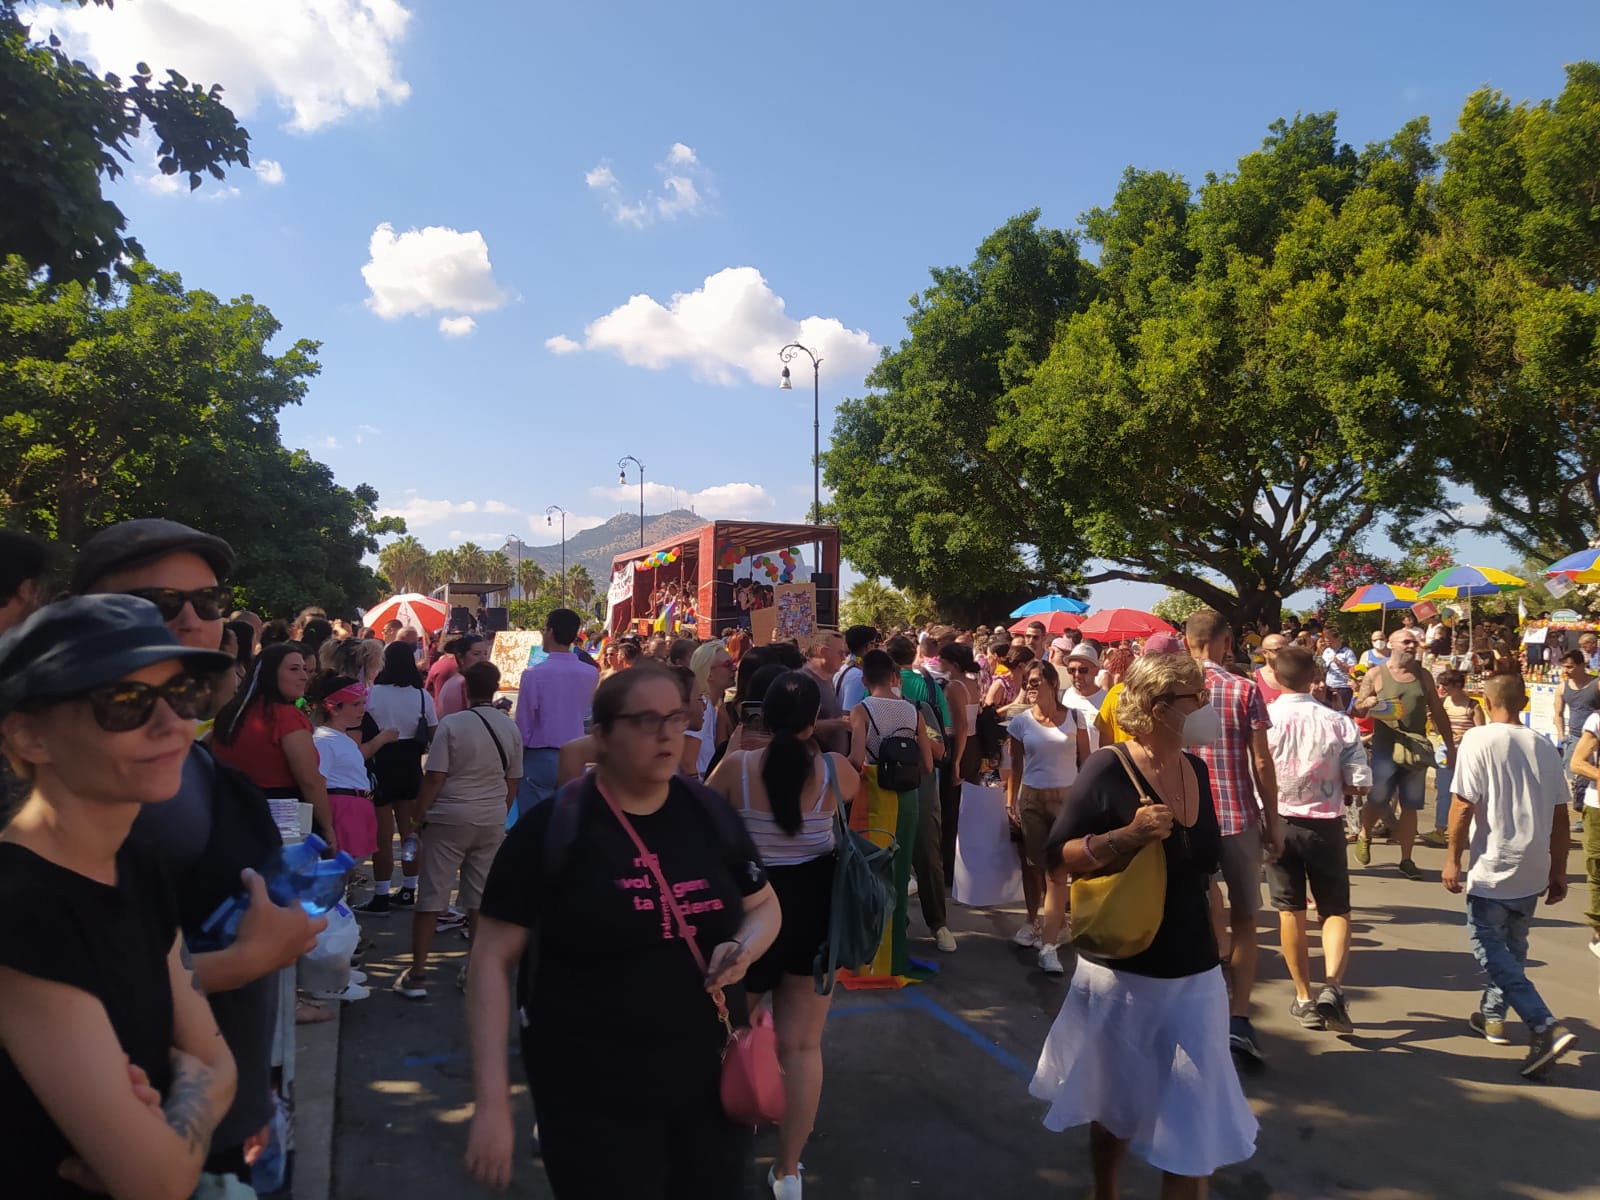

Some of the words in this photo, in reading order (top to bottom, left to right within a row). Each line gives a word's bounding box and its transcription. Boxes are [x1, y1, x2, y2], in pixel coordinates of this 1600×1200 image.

[615, 874, 652, 889] vol
[672, 879, 709, 897] gen
[633, 895, 654, 910] ta
